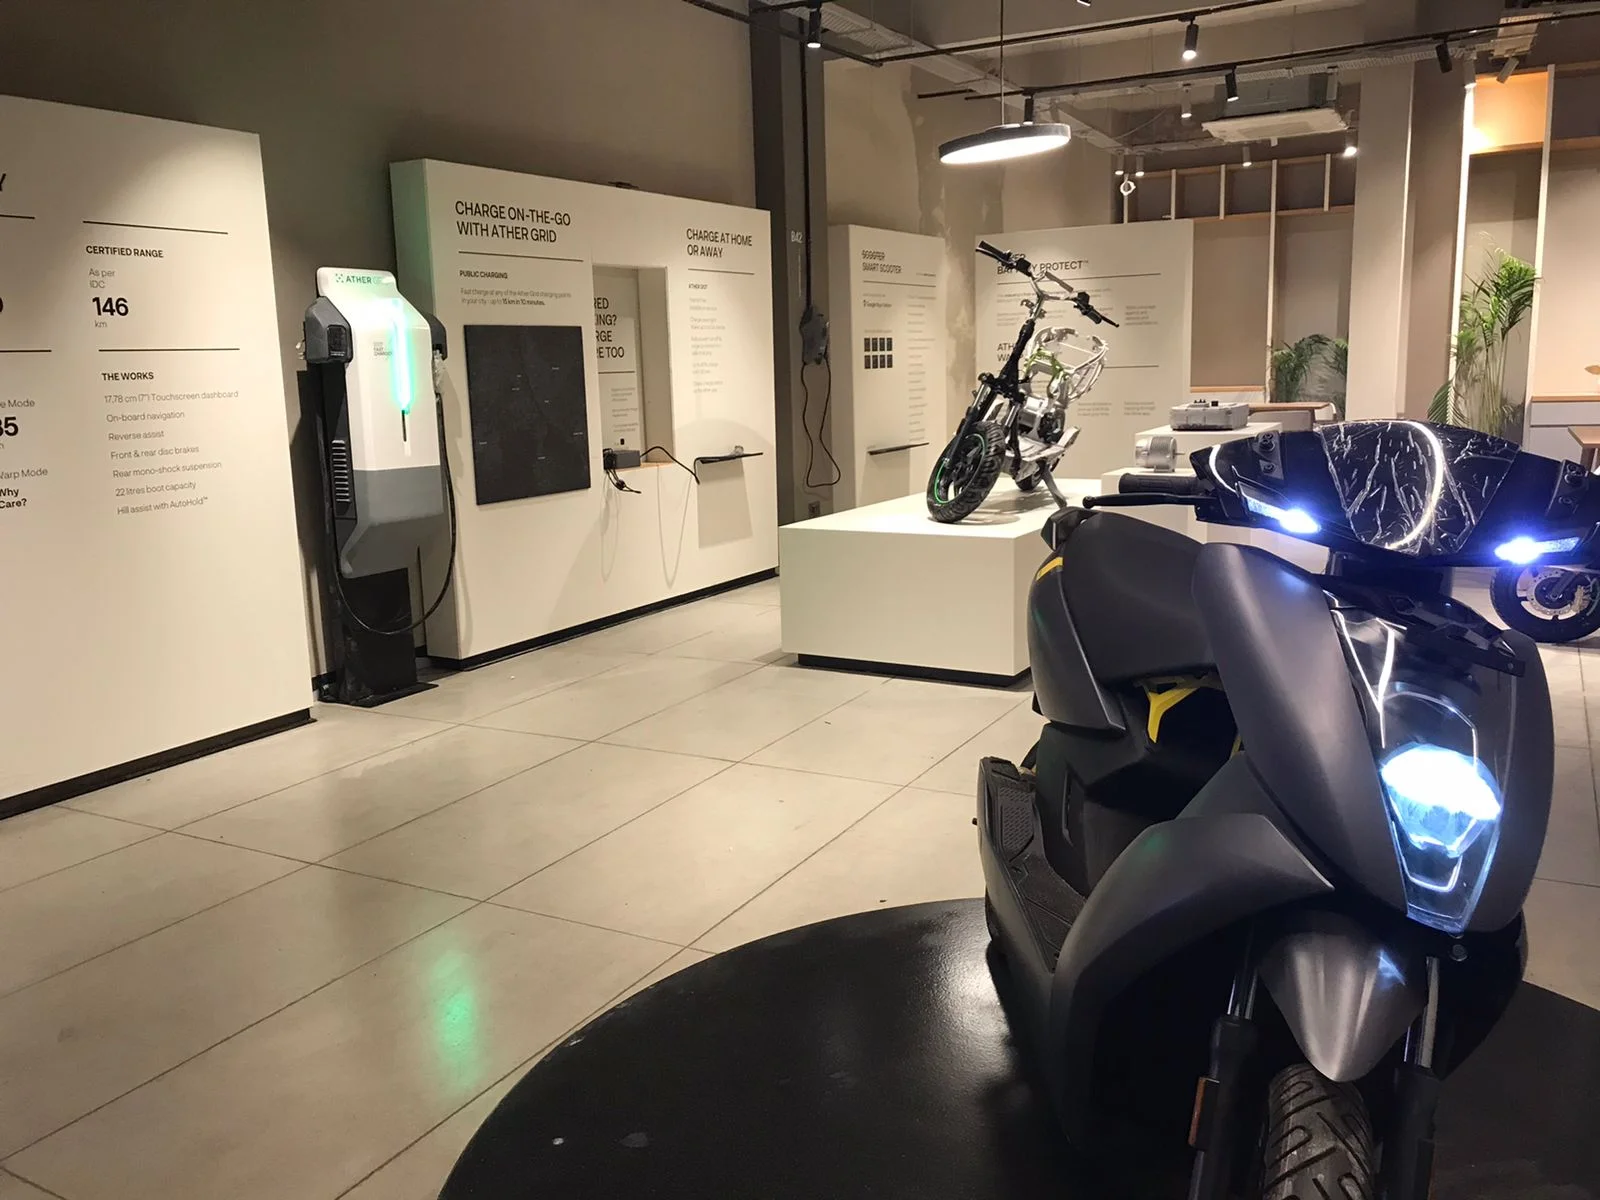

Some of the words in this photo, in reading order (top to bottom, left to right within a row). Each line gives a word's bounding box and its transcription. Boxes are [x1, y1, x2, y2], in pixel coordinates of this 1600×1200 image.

[455, 200, 506, 219] CHARGE
[508, 207, 571, 226] ON-THE-GO
[456, 221, 489, 237] WITH
[491, 224, 529, 240] ATHER
[530, 228, 557, 243] GRID
[686, 228, 719, 243] CHARGE
[720, 232, 730, 244] AT
[731, 234, 753, 247] HOME
[790, 230, 803, 243] B42
[86, 245, 132, 256] CERTIFIED
[134, 249, 164, 258] RANGE
[687, 244, 699, 256] OR
[700, 246, 723, 258] AWAY
[89, 268, 100, 277] As
[101, 270, 116, 278] per
[459, 270, 479, 278] PUBLIC
[480, 271, 508, 279] CHARGING
[880, 264, 902, 274] SCOOTER
[90, 280, 106, 289] IDC
[345, 275, 372, 284] ATHER
[92, 297, 129, 316] 146
[94, 320, 108, 328] km
[605, 346, 625, 359] TOO
[101, 373, 120, 381] THE
[120, 372, 154, 380] WORKS
[151, 391, 200, 401] Touchscreen
[202, 390, 239, 399] dashboard
[8, 398, 35, 408] Mode
[106, 412, 146, 422] On-board
[146, 411, 185, 421] navigation
[108, 431, 142, 441] Reverse
[143, 430, 165, 439] assist
[110, 450, 132, 460] Front
[133, 450, 140, 458] &
[141, 449, 157, 458] rear
[158, 447, 174, 456] disc
[174, 446, 200, 455] brakes
[21, 468, 48, 478] Mode
[113, 468, 132, 478] Rear
[133, 464, 181, 477] mono-shock
[181, 461, 222, 473] suspension
[0, 487, 19, 497] Why
[115, 487, 126, 497] 22
[126, 486, 146, 496] litres
[146, 484, 164, 494] boot
[165, 481, 197, 493] capacity
[0, 497, 27, 509] Care?
[117, 506, 130, 515] Hill
[130, 504, 152, 514] assist
[153, 501, 169, 511] with
